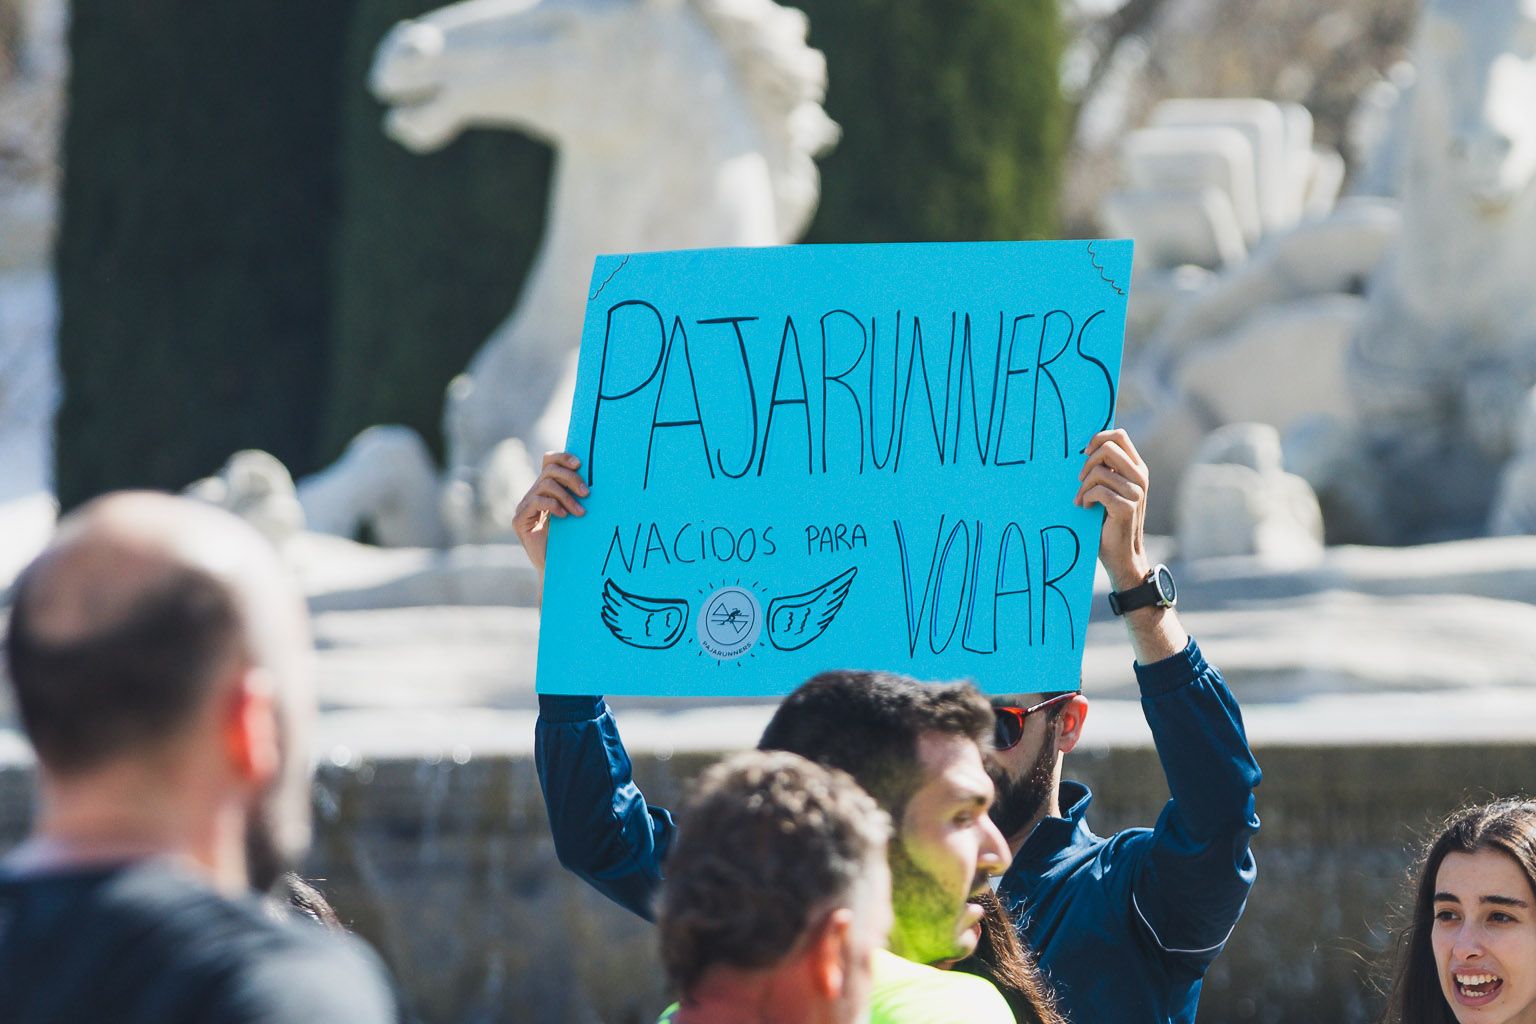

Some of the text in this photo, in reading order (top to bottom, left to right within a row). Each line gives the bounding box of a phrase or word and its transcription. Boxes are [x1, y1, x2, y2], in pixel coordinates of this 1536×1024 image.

[588, 299, 1115, 489] PAJARUNNERS
[702, 640, 752, 657] PAJARUNNERS
[805, 523, 868, 556] PARA
[893, 514, 1081, 659] VOLAR
